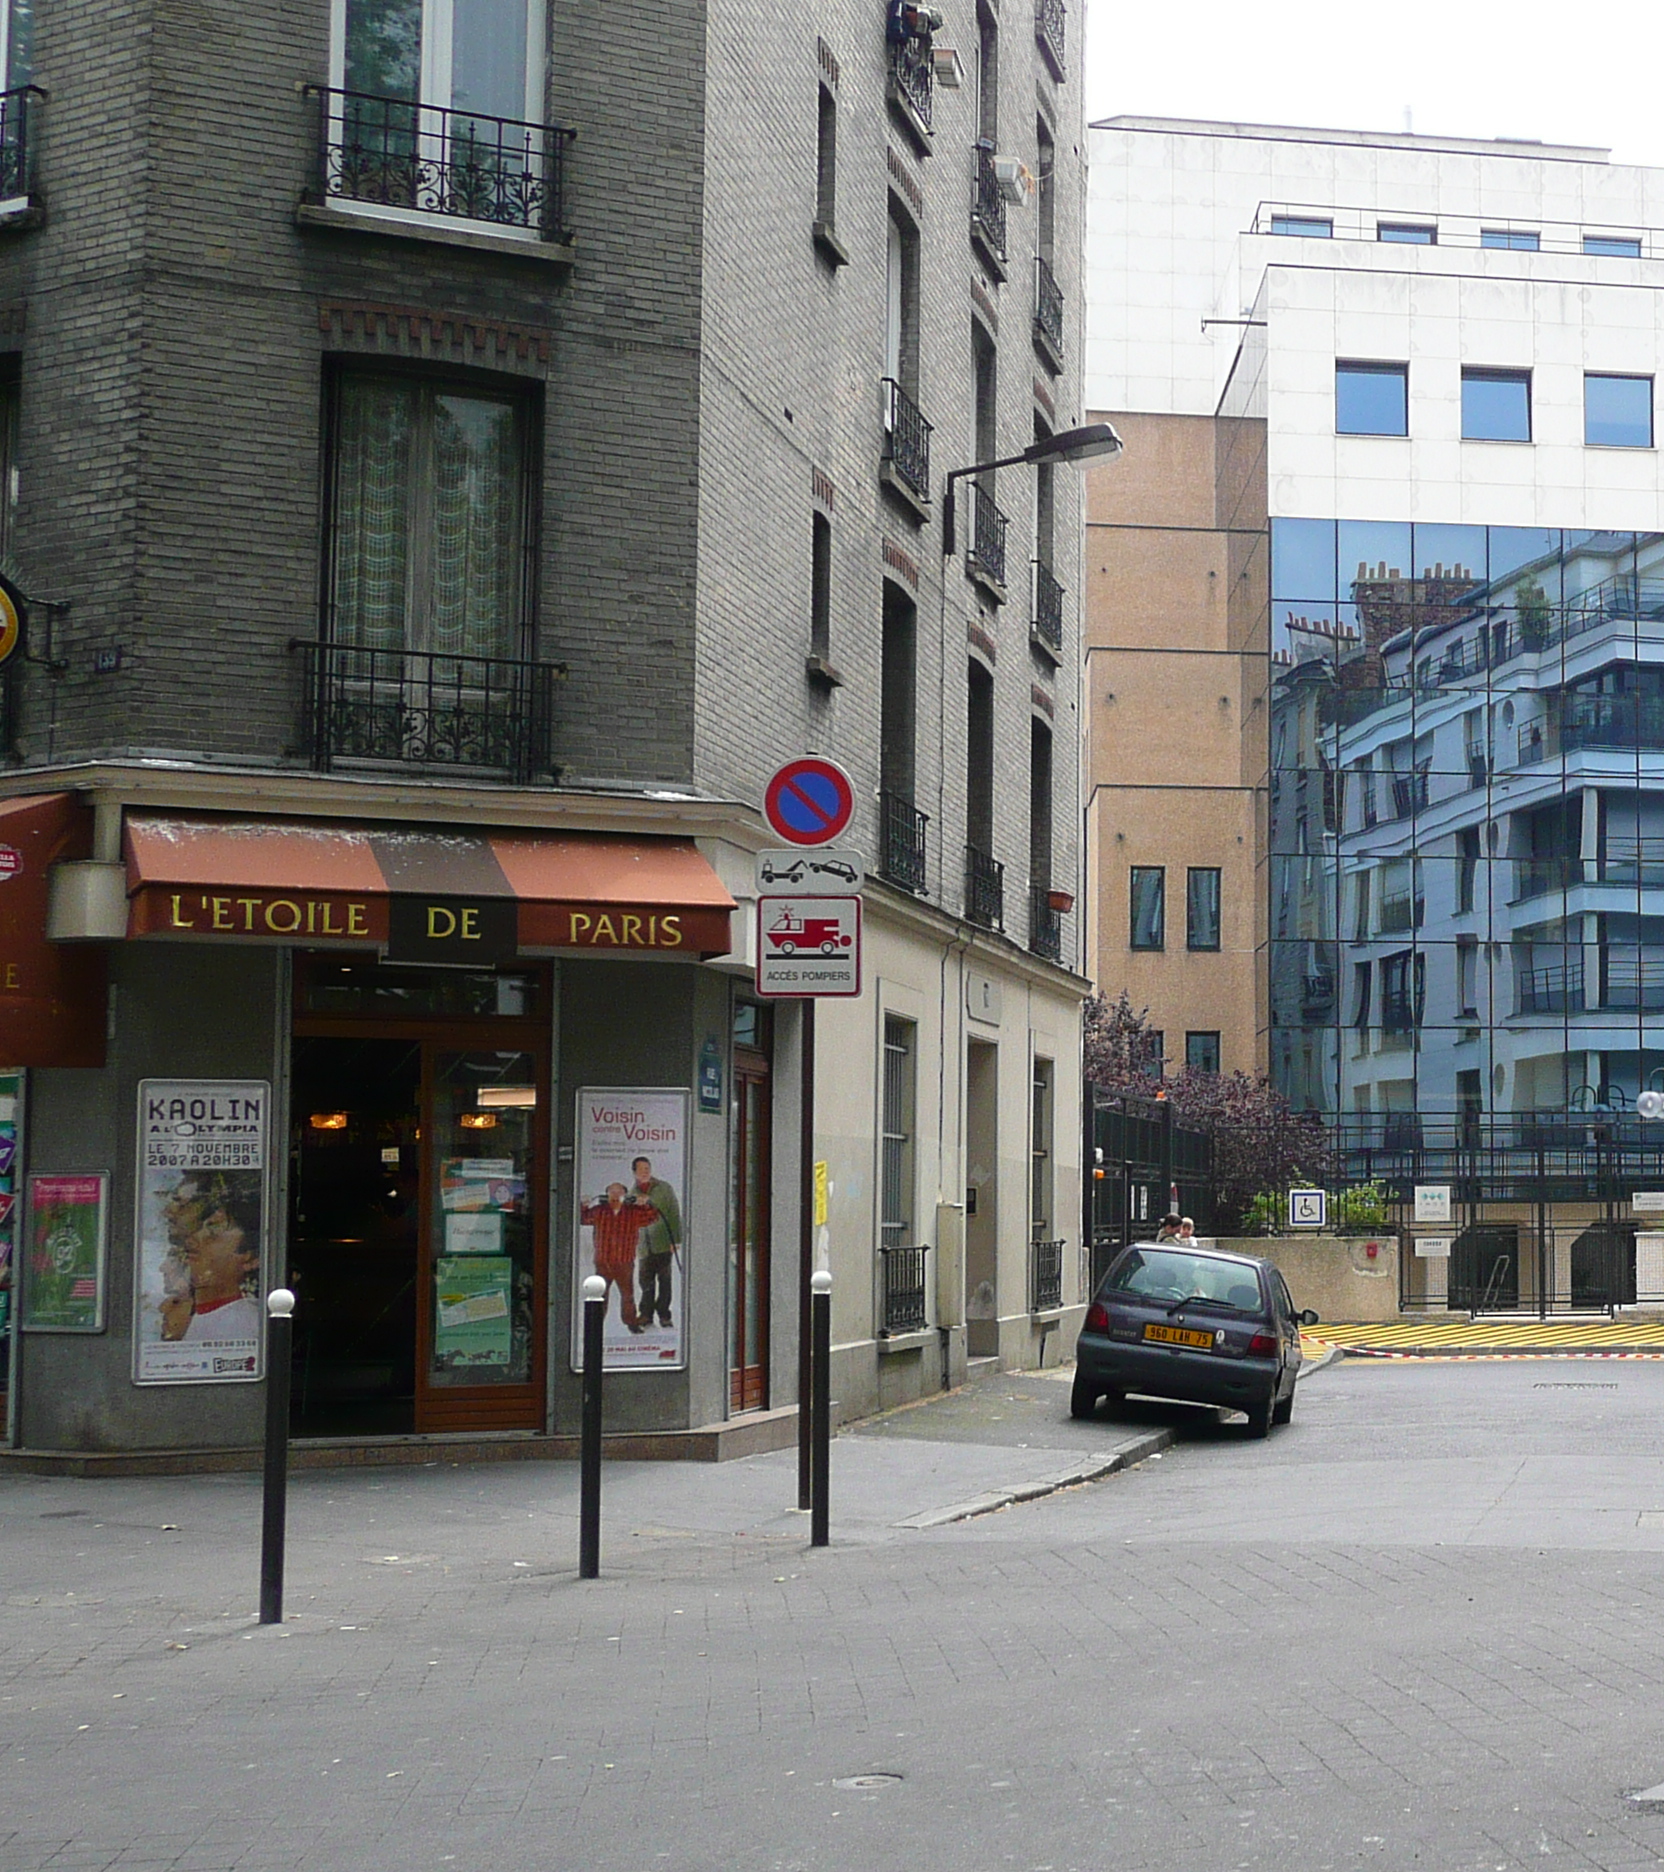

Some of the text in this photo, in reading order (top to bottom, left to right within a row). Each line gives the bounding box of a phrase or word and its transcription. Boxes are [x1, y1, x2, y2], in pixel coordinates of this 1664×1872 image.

[170, 894, 683, 948] L'ETOILE DE PARIS
[801, 971, 851, 982] POMPIERS
[149, 1099, 260, 1120] KAOLIN
[591, 1106, 645, 1123] Voisin
[592, 1124, 676, 1141] contre Voisin
[148, 1143, 259, 1154] LE 7 NOVEMBRE
[148, 1155, 251, 1166] 2007 A 20H30
[1150, 1327, 1208, 1346] 960 LAH 75
